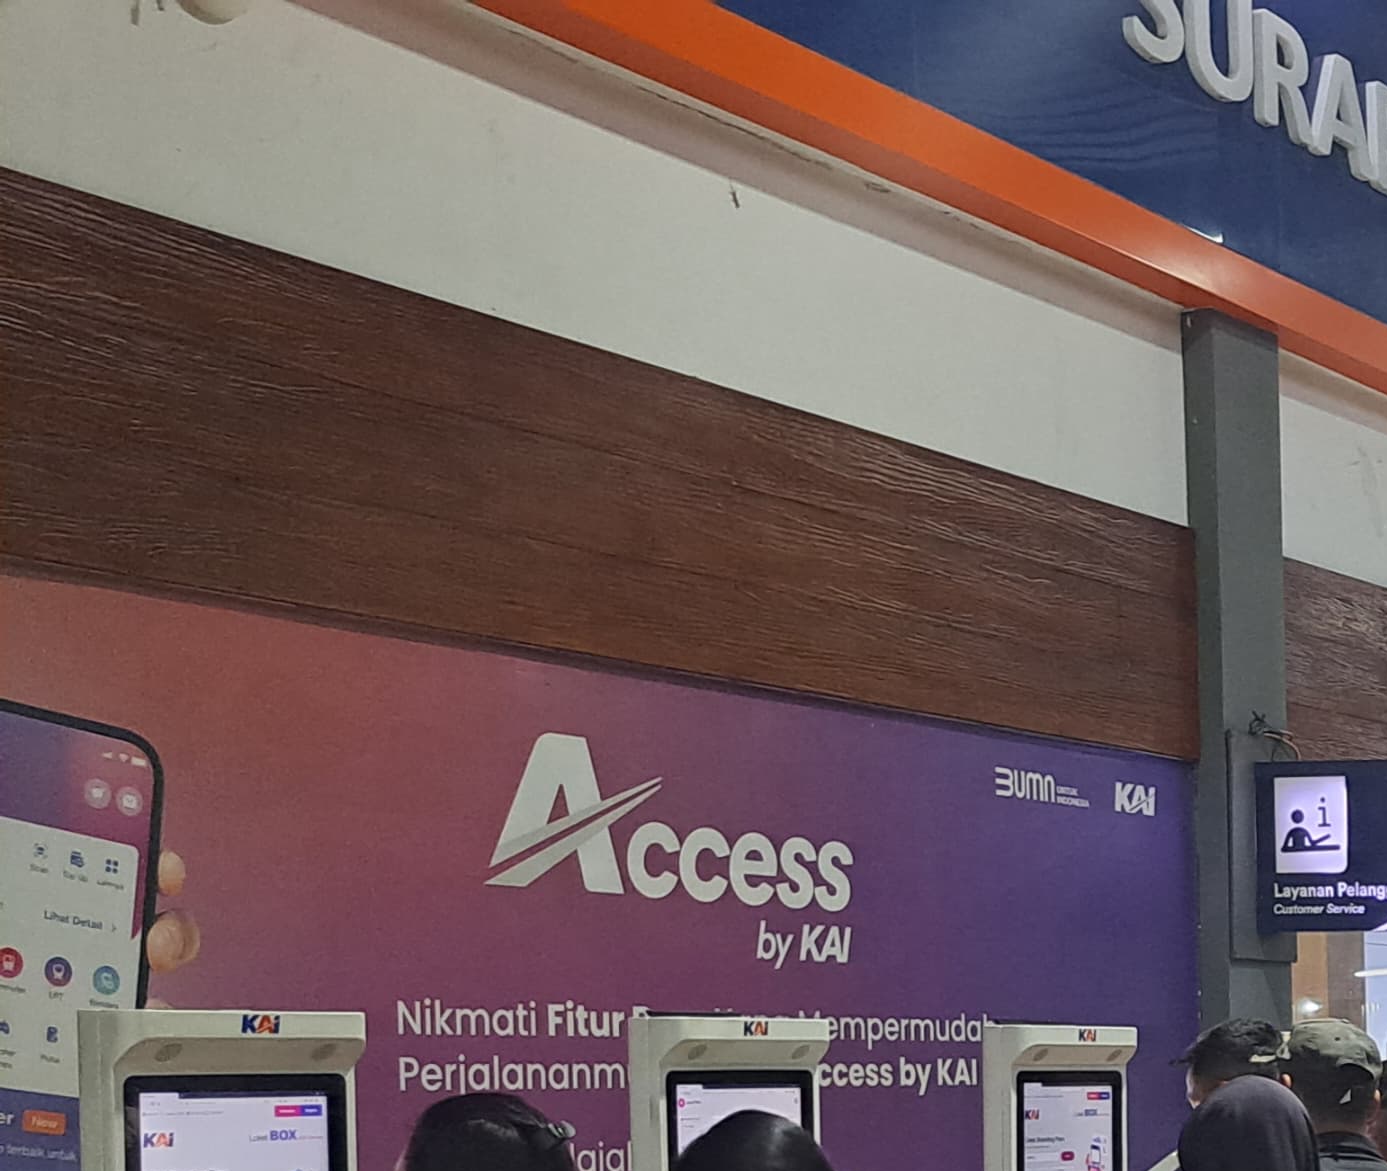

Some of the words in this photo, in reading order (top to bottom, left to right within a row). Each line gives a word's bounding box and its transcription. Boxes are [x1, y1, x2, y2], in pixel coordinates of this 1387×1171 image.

[1114, 782, 1156, 817] KAI
[484, 732, 854, 912] Access
[1273, 883, 1334, 901] Layanan
[1273, 904, 1324, 914] Customer
[1326, 903, 1366, 914] Service
[756, 920, 794, 969] by
[799, 924, 851, 963] KAI
[241, 1014, 281, 1034] KAI
[397, 997, 537, 1036] Nikmati
[548, 999, 625, 1037] Fitur
[743, 1021, 768, 1036] KAI
[1078, 1029, 1097, 1042] KAI
[399, 1053, 630, 1094] Perjalananm
[815, 1061, 893, 1087] ccess
[900, 1057, 931, 1096] by
[937, 1058, 978, 1086] KAI
[143, 1133, 175, 1147] KAI
[270, 1130, 298, 1141] BOX
